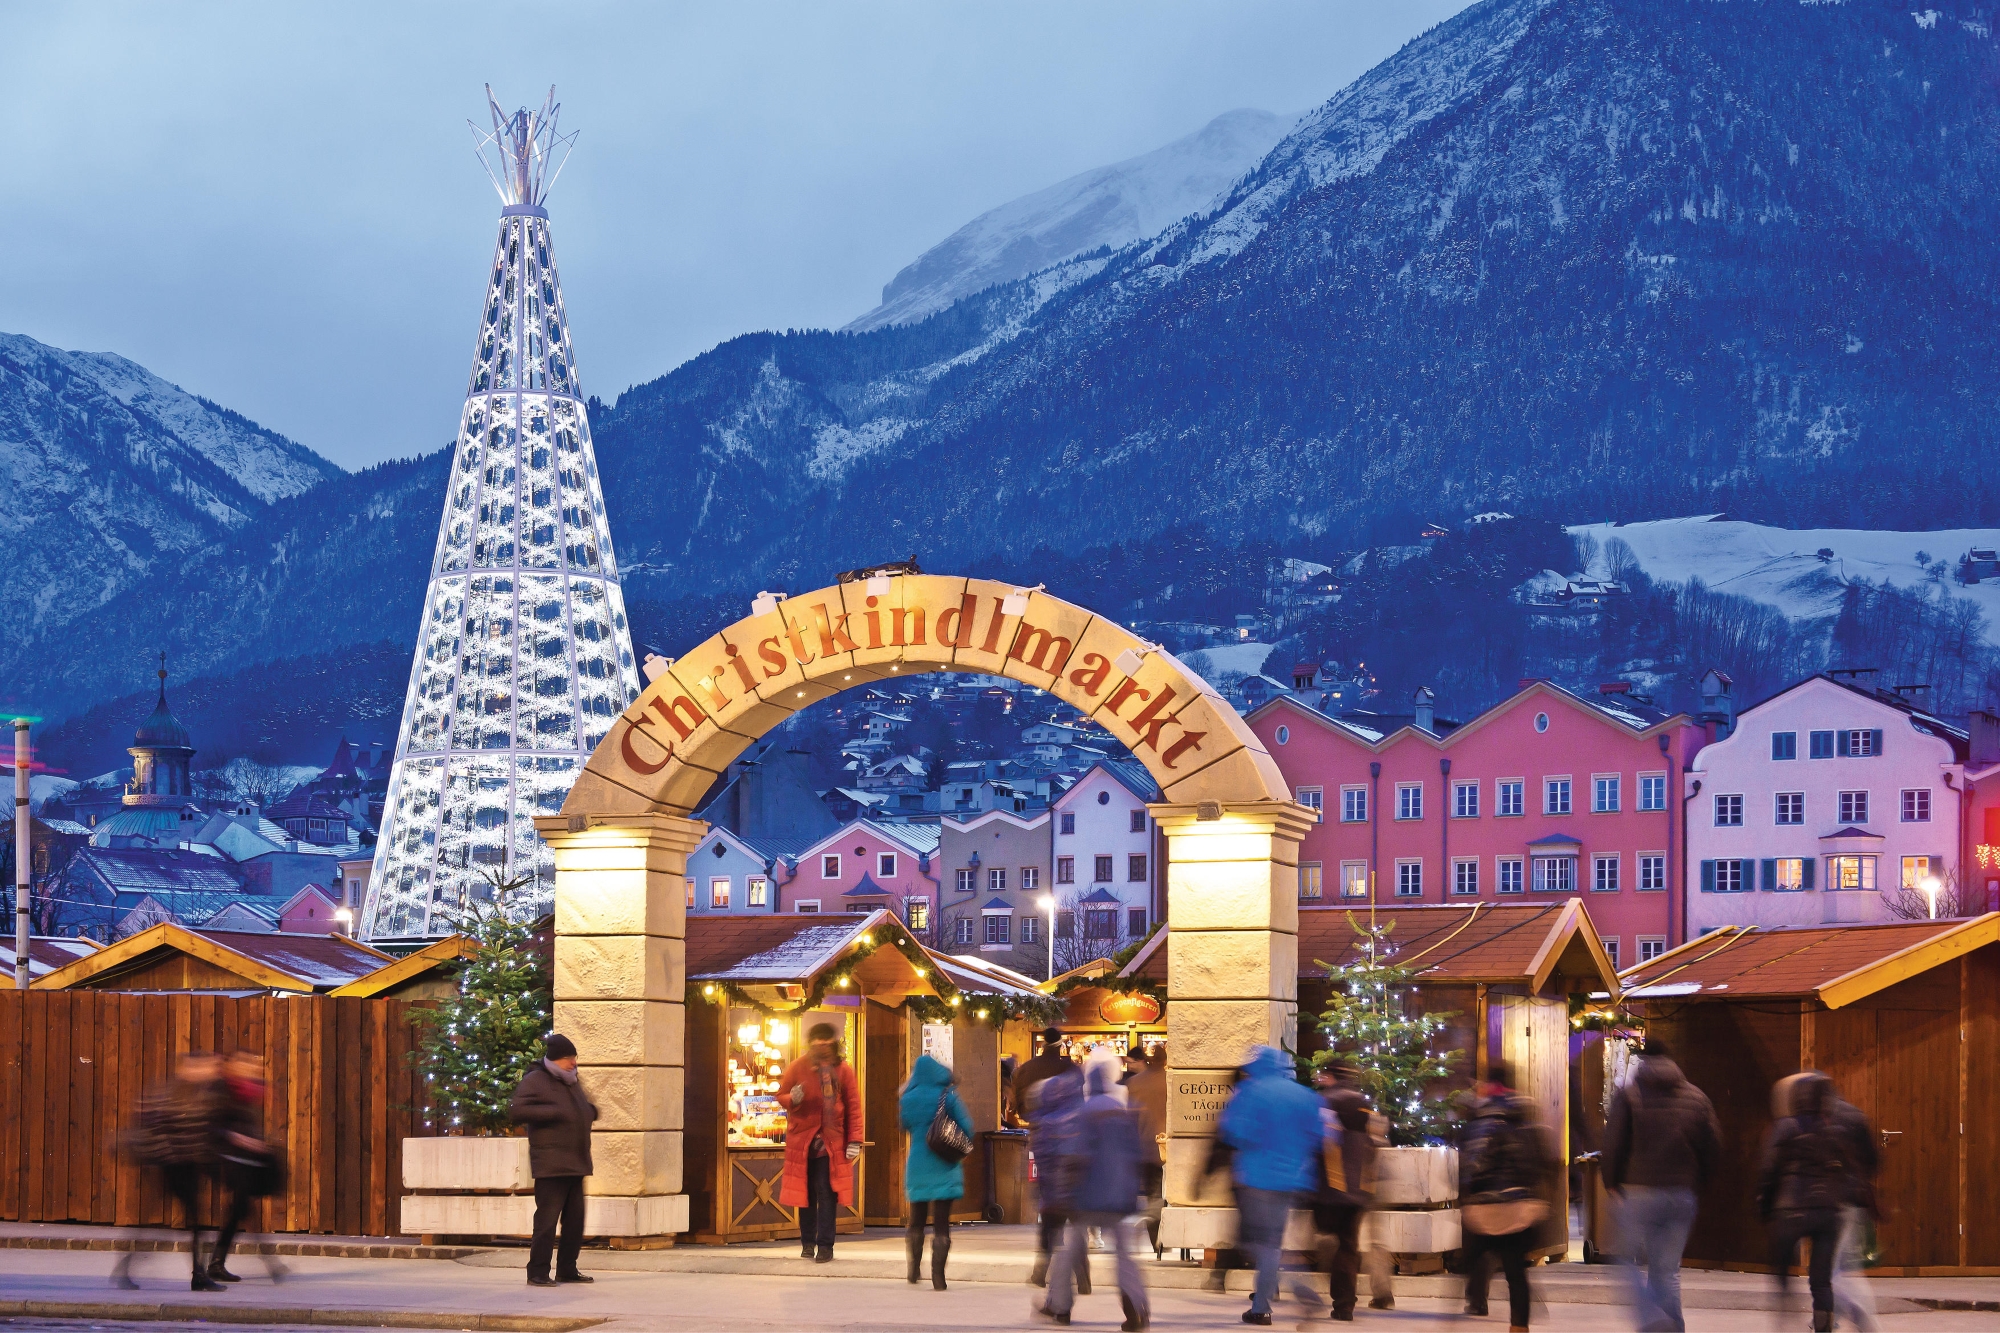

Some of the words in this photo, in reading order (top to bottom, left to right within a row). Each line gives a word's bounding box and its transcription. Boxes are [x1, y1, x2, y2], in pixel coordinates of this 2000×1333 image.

[622, 593, 1207, 775] Christkindlmarkt
[1103, 998, 1158, 1013] Krippenfiguren
[1205, 1113, 1215, 1121] 11
